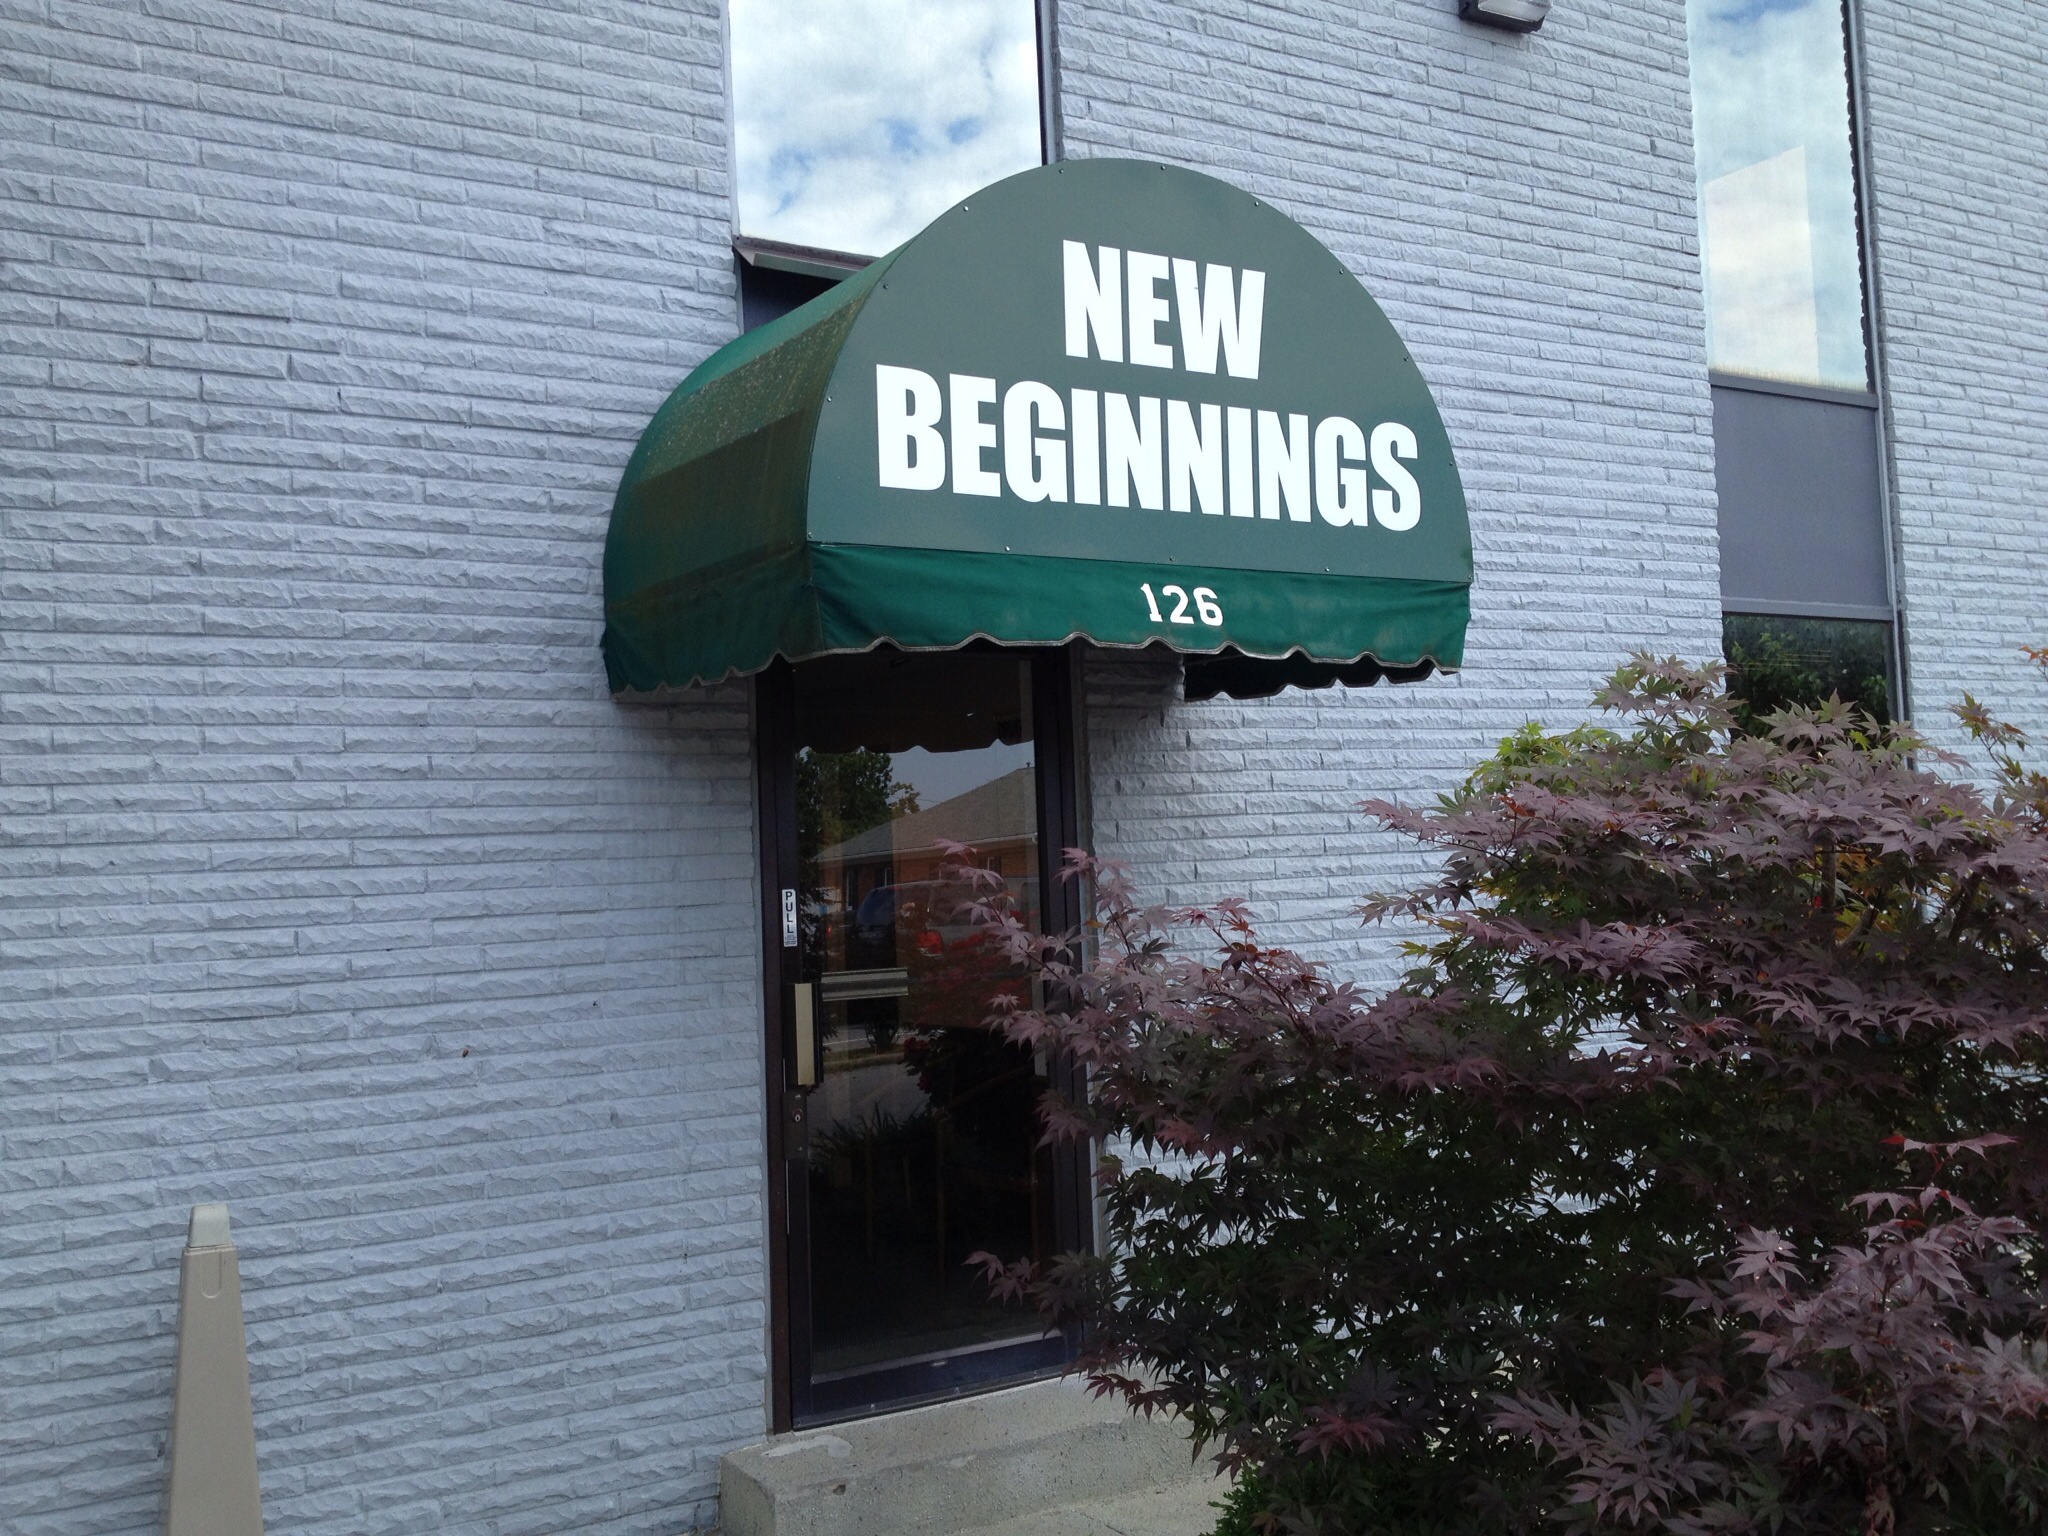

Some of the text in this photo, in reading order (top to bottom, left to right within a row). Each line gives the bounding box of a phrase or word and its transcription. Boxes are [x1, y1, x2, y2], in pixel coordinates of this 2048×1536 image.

[1062, 240, 1266, 380] NEW
[876, 364, 1421, 532] BEGINNINGS
[1141, 583, 1224, 627] 126
[785, 891, 795, 934] PULL
